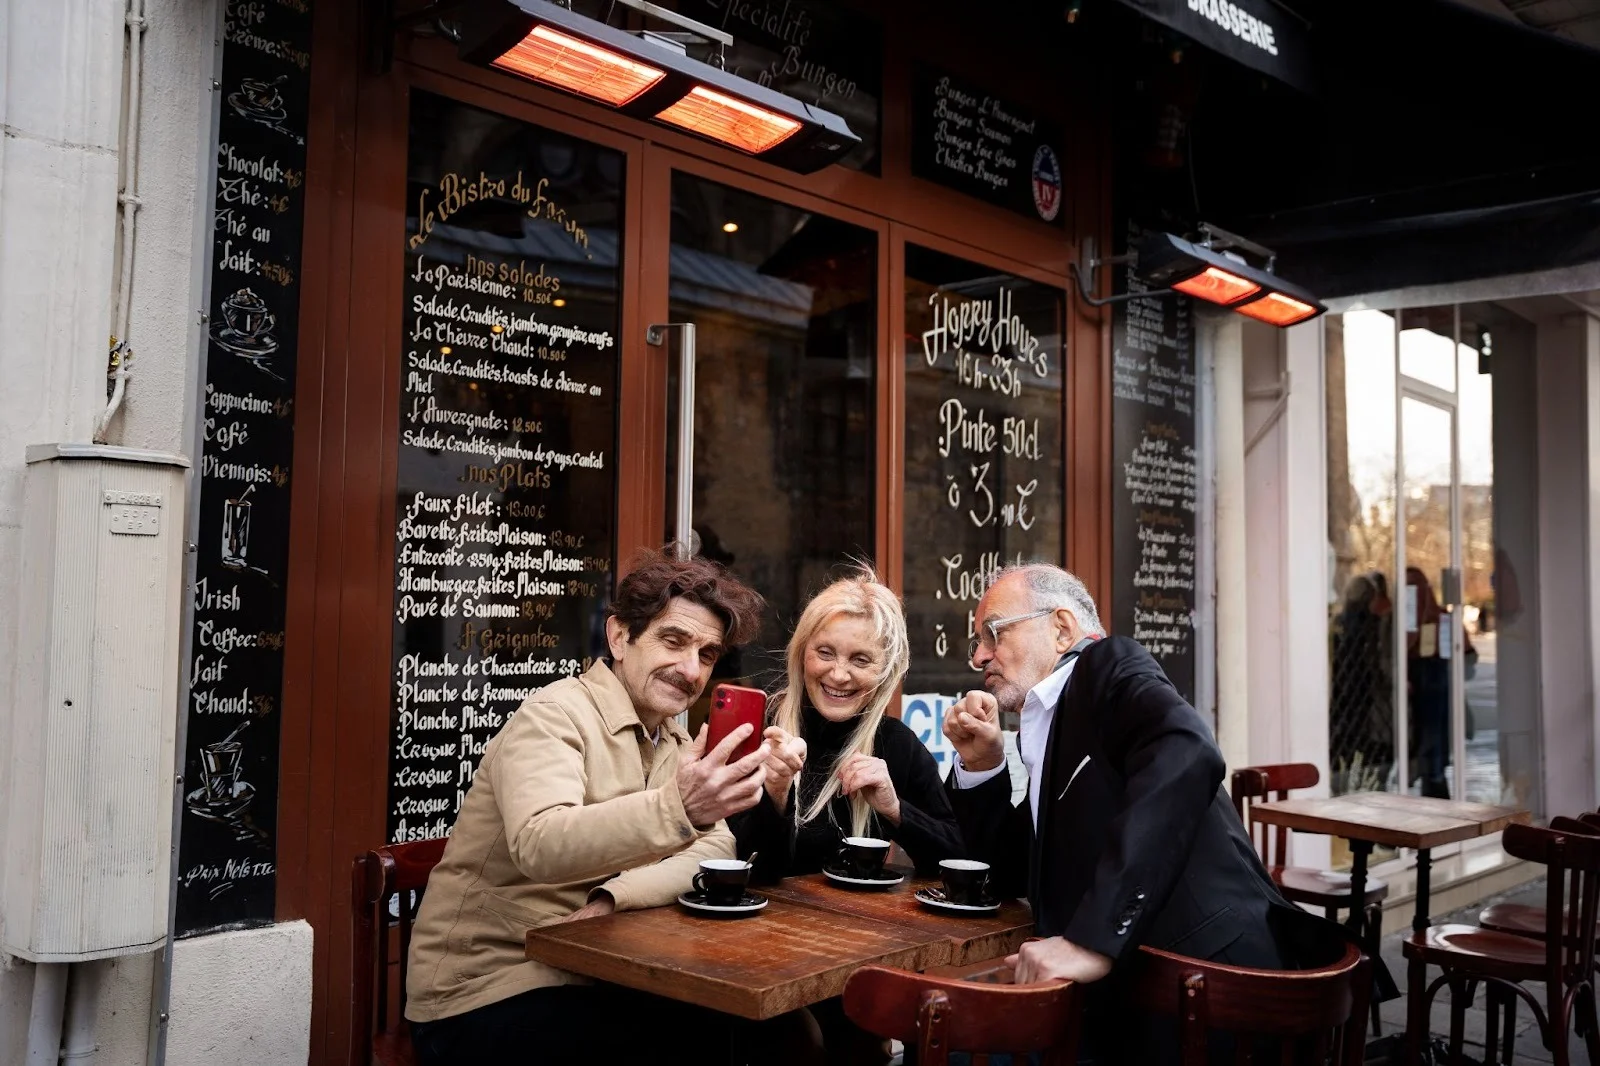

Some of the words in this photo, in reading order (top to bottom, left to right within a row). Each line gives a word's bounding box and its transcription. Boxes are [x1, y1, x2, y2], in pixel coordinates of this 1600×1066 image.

[409, 188, 434, 249] Le
[438, 171, 505, 221] Bistro
[511, 170, 530, 203] du
[252, 227, 271, 243] au
[498, 260, 560, 292] Salades
[922, 292, 993, 366] Happy
[991, 286, 1048, 378] Hours
[540, 369, 553, 389] de
[203, 418, 250, 452] Café
[938, 398, 997, 458] Pinte
[498, 460, 551, 493] Plats
[397, 595, 438, 624] Pavé
[440, 594, 457, 618] de
[397, 652, 459, 687] Planche
[462, 655, 478, 677] de
[480, 652, 557, 677] Charcuterie
[192, 687, 254, 715] Chaud:
[397, 680, 459, 713] Planche
[462, 679, 479, 703] de
[397, 708, 458, 740] Planche
[459, 705, 502, 733] Mixte
[396, 737, 456, 761] Croque
[396, 766, 452, 788] Croque
[396, 796, 450, 817] Croque
